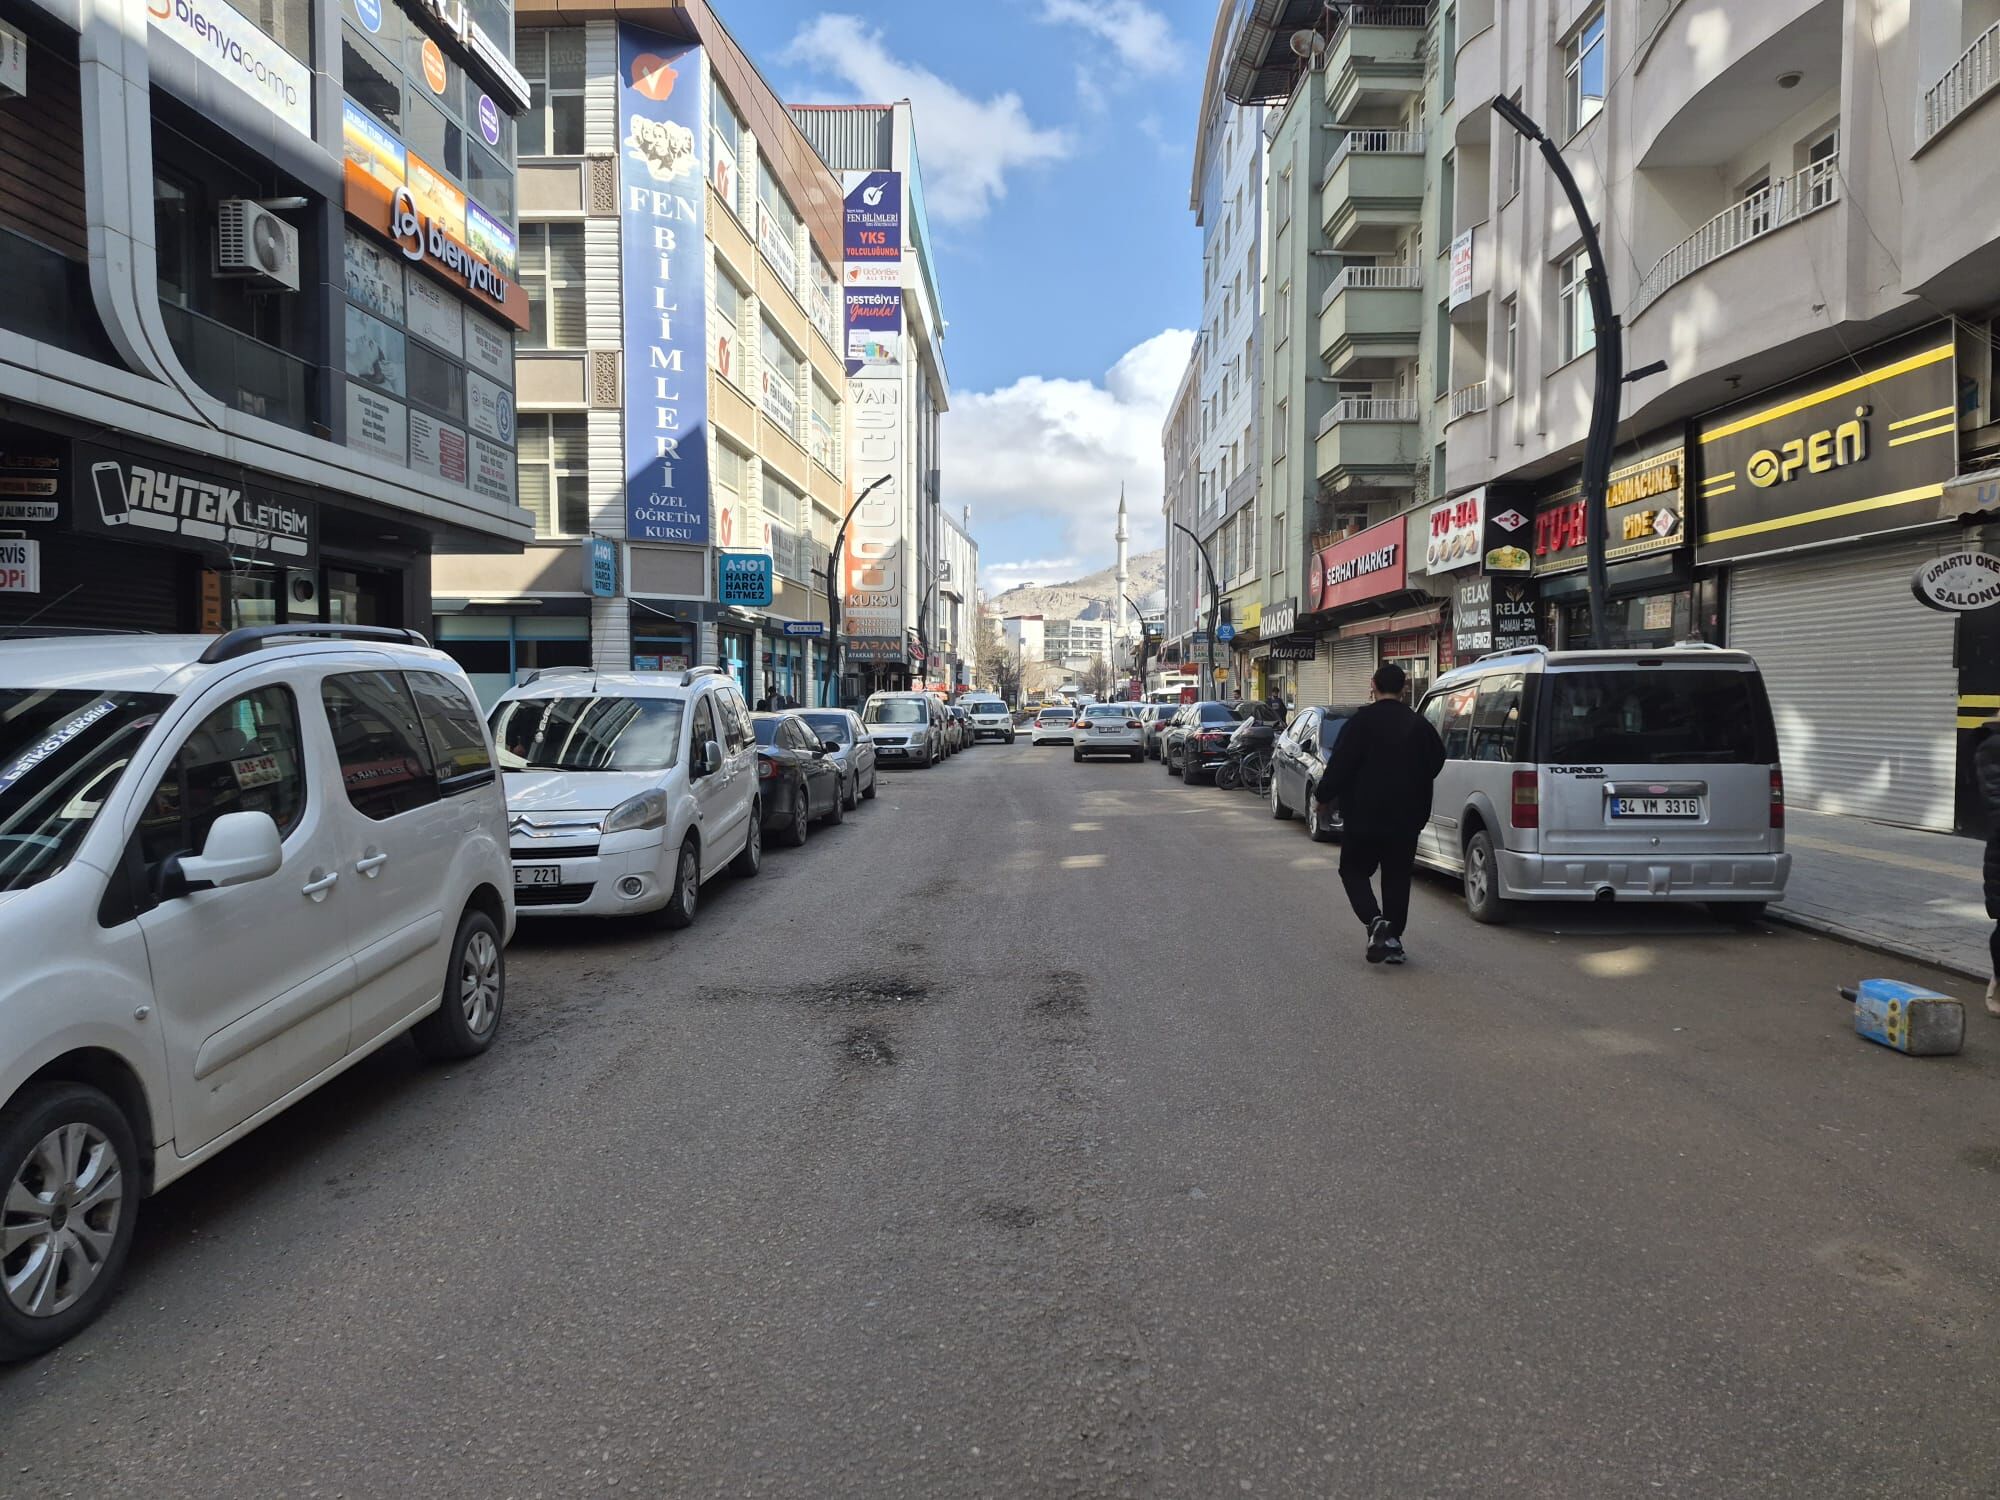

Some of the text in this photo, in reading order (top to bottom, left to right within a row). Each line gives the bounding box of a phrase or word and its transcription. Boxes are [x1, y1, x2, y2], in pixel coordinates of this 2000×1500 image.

[175, 0, 297, 105] bienyacamp
[628, 185, 698, 225] FEN
[847, 211, 898, 222] FEN BİLİMLERİ
[859, 232, 886, 244] YKS
[846, 246, 899, 257] YOLCULUĞUNDA
[428, 217, 509, 304] bienyatur
[846, 294, 900, 304] DESTEĞİYLE
[851, 389, 897, 405] VAN
[128, 465, 241, 526] AYTEK
[649, 492, 688, 508] ÖZEL
[635, 507, 701, 525] ÖĞRETİM
[1431, 498, 1479, 537] TU-HA
[1510, 513, 1520, 527] 3
[645, 525, 692, 540] KURSU
[1535, 500, 1588, 556] TU-H
[594, 560, 611, 571] HARCA
[1326, 559, 1356, 586] SERHAT
[1357, 543, 1396, 577] MARKET
[1927, 554, 1973, 583] URARTU
[594, 570, 611, 581] HARCA
[725, 573, 765, 581] HARCA
[725, 582, 765, 590] HARCA
[850, 593, 899, 607] KURSU
[1461, 583, 1490, 605] RELAX
[1495, 602, 1536, 615] RELAX
[1260, 603, 1294, 637] KUAFÖR
[1548, 766, 1604, 775] TOURNEO
[1620, 799, 1636, 813] 34
[1665, 799, 1697, 813] 3316
[534, 869, 556, 883] 221
